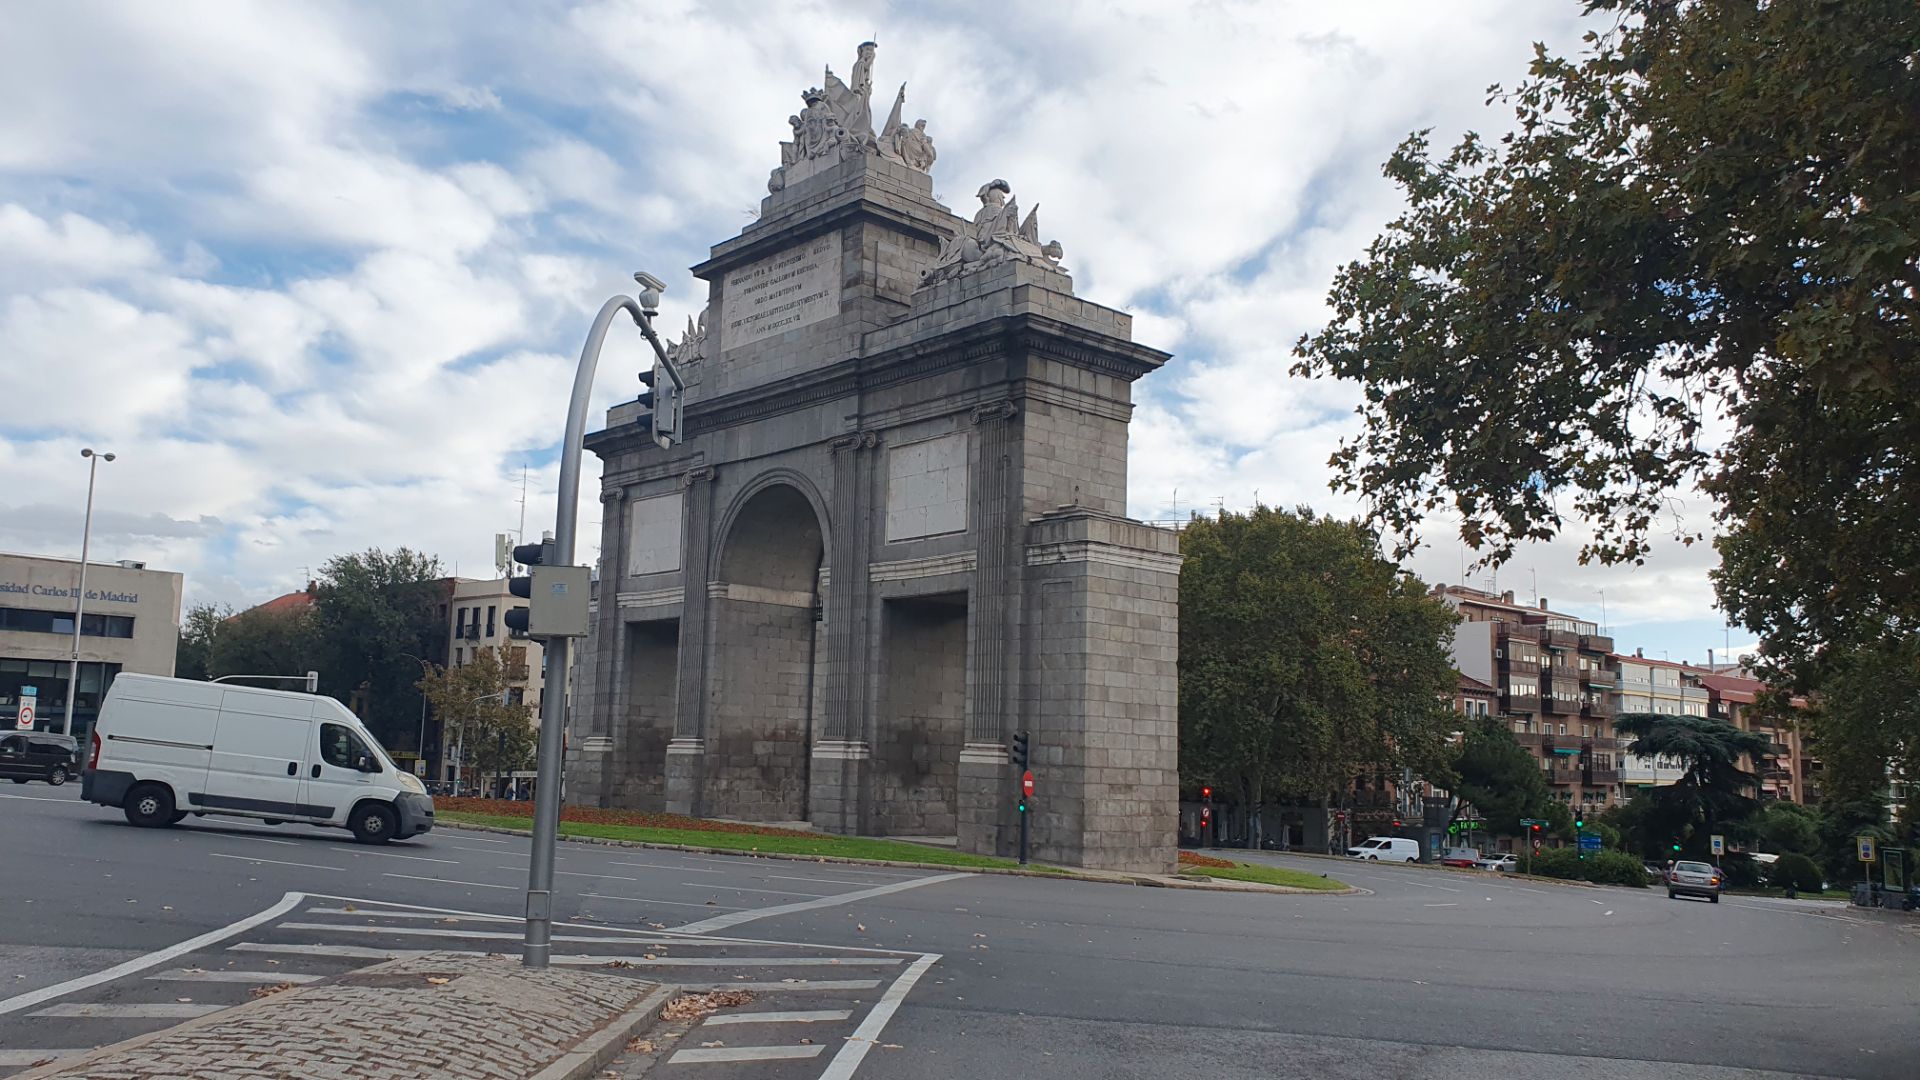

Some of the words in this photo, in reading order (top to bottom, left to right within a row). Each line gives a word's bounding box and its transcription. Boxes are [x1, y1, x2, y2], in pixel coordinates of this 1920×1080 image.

[32, 584, 67, 598] Carlos
[85, 590, 98, 600] de
[99, 591, 138, 604] Madrid
